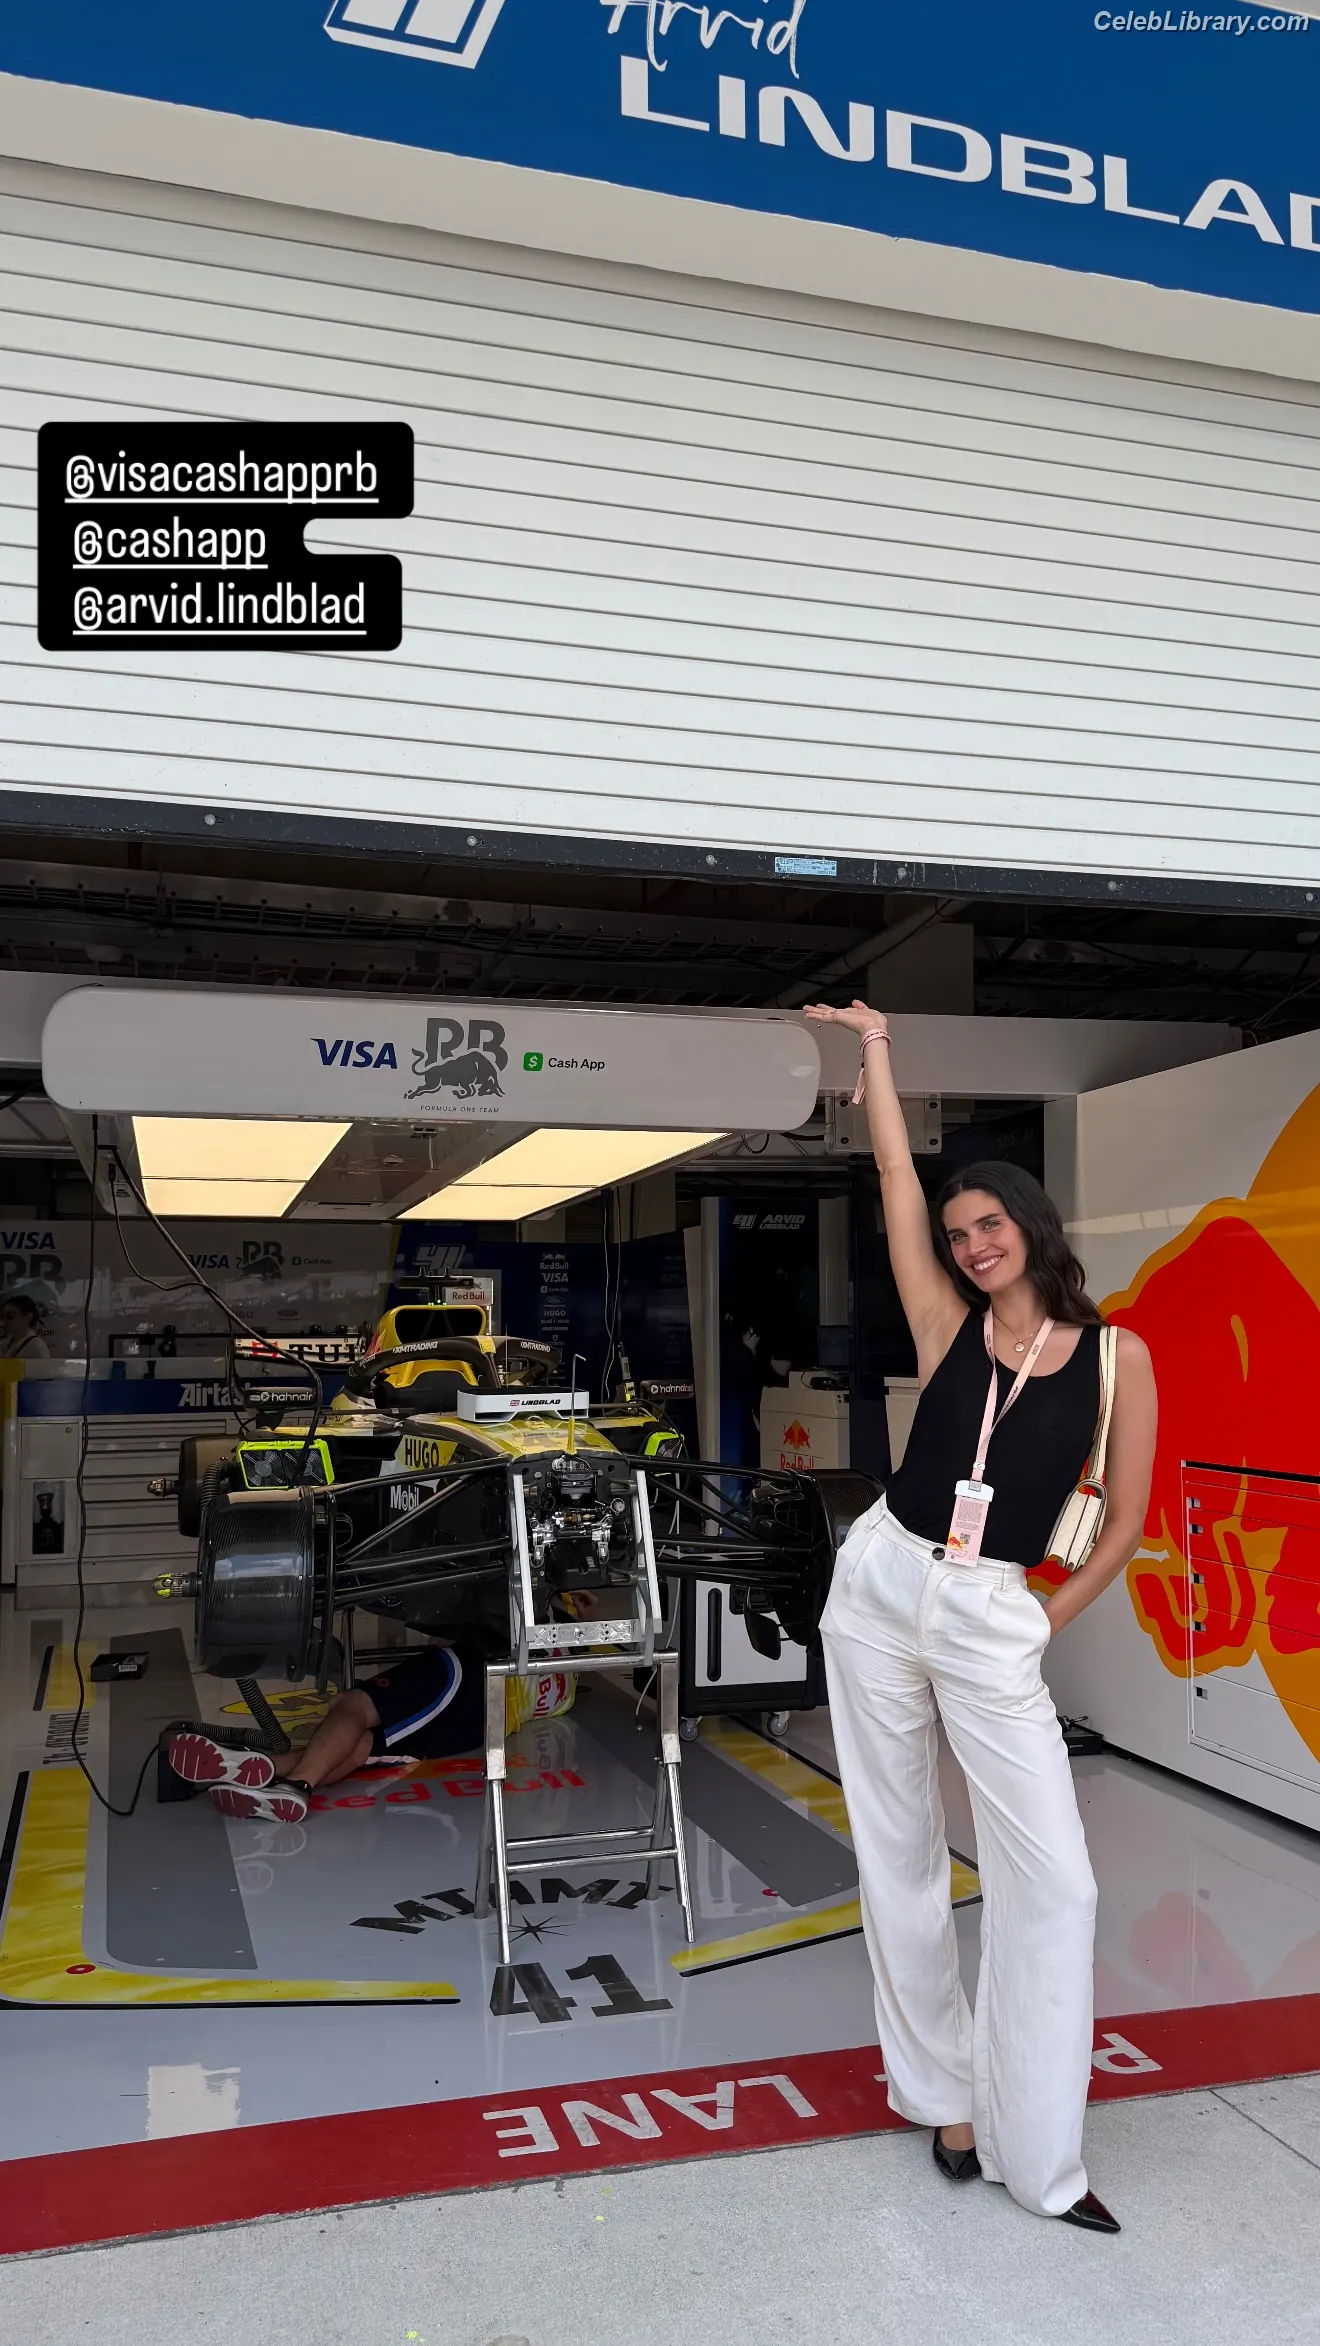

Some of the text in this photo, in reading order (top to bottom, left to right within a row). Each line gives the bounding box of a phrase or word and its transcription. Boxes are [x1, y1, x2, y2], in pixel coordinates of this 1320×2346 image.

[600, 0, 807, 79] Arvid
[620, 55, 1320, 253] LINDBLA
[309, 1037, 398, 1070] VISA
[547, 1057, 606, 1072] Cash App
[420, 1105, 457, 1113] FORMULA
[762, 1214, 806, 1224] ARVID
[0, 1231, 56, 1250] VISA
[187, 1254, 230, 1270] VISA
[541, 1272, 569, 1283] VISA
[271, 1391, 313, 1402] hahnair
[521, 1398, 561, 1406] LINDBLAD
[404, 1437, 440, 1469] HUGO
[390, 1484, 420, 1512] Mobil
[532, 1677, 551, 1717] Bull
[442, 1769, 587, 1799] Bull
[349, 1877, 675, 1935] MIAMI
[489, 1953, 674, 2024] 41
[481, 2073, 819, 2159] LANE
